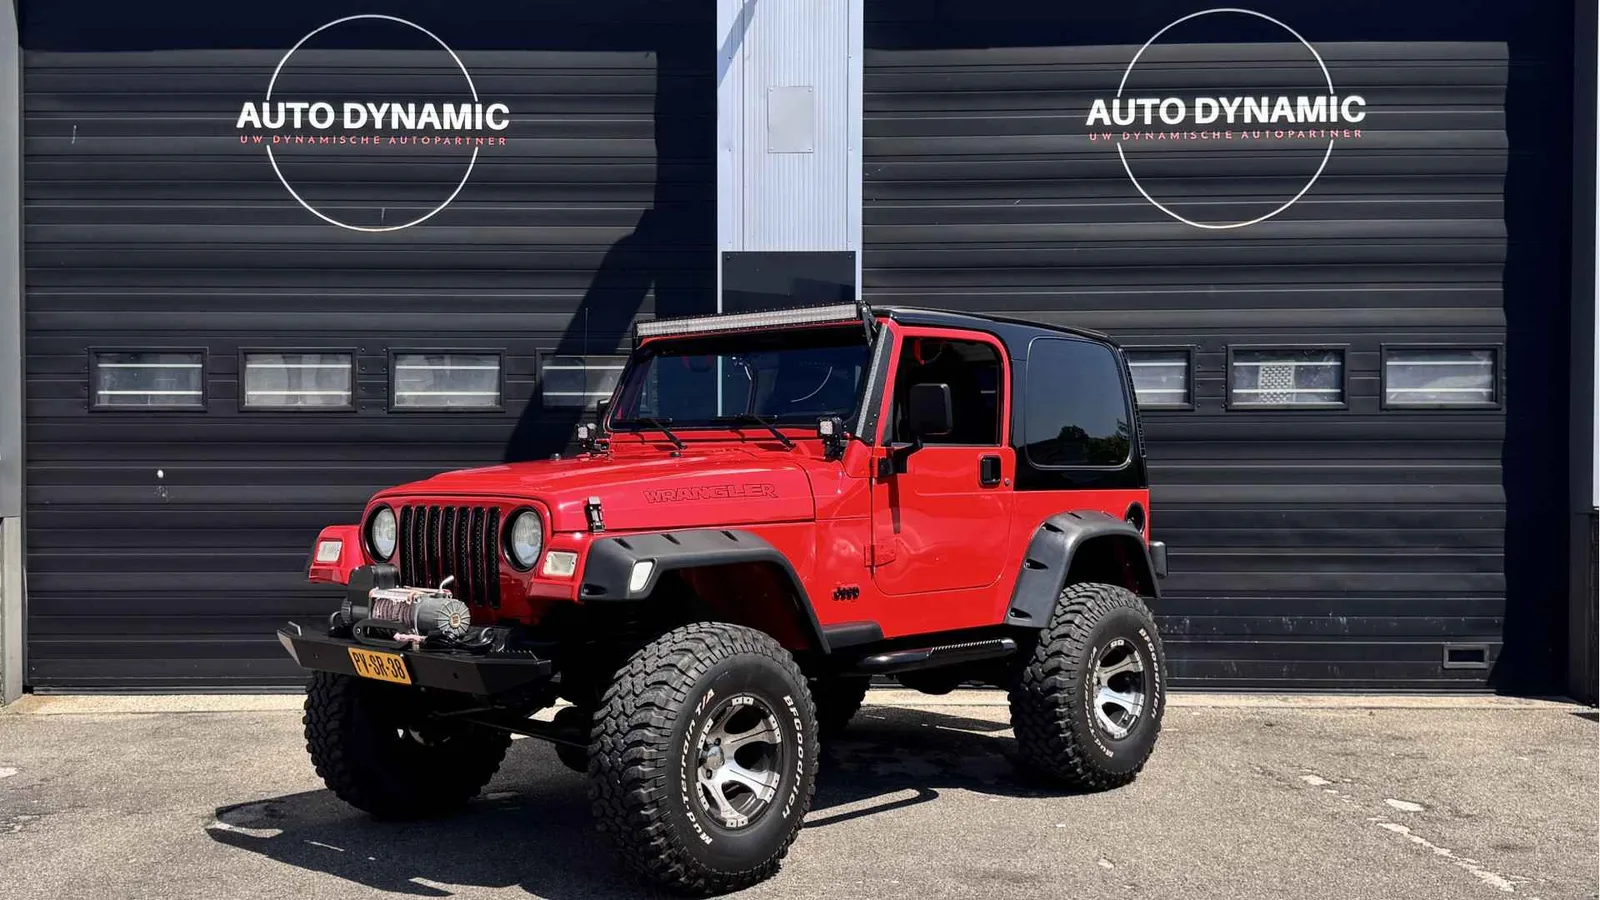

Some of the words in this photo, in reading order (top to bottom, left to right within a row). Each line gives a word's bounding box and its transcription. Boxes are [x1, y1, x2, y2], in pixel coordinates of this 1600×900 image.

[236, 102, 335, 129] AUTO
[343, 103, 510, 130] DYNAMIC
[1086, 98, 1186, 126] AUTO
[1195, 95, 1366, 124] DYNAMIC
[240, 135, 263, 144] UW
[273, 135, 381, 145] DYNAMISCHE
[389, 136, 507, 146] AUTOPARTNER
[1089, 132, 1113, 141] UW
[1122, 130, 1233, 140] DYNAMISCHE
[1241, 129, 1363, 140] AUTOPARTNER
[643, 483, 778, 503] WRANGLER
[351, 652, 406, 679] PV-SR-38
[695, 688, 715, 716] T/A
[783, 695, 804, 819] BFGoodrich
[680, 719, 713, 845] Mud-Terrain
